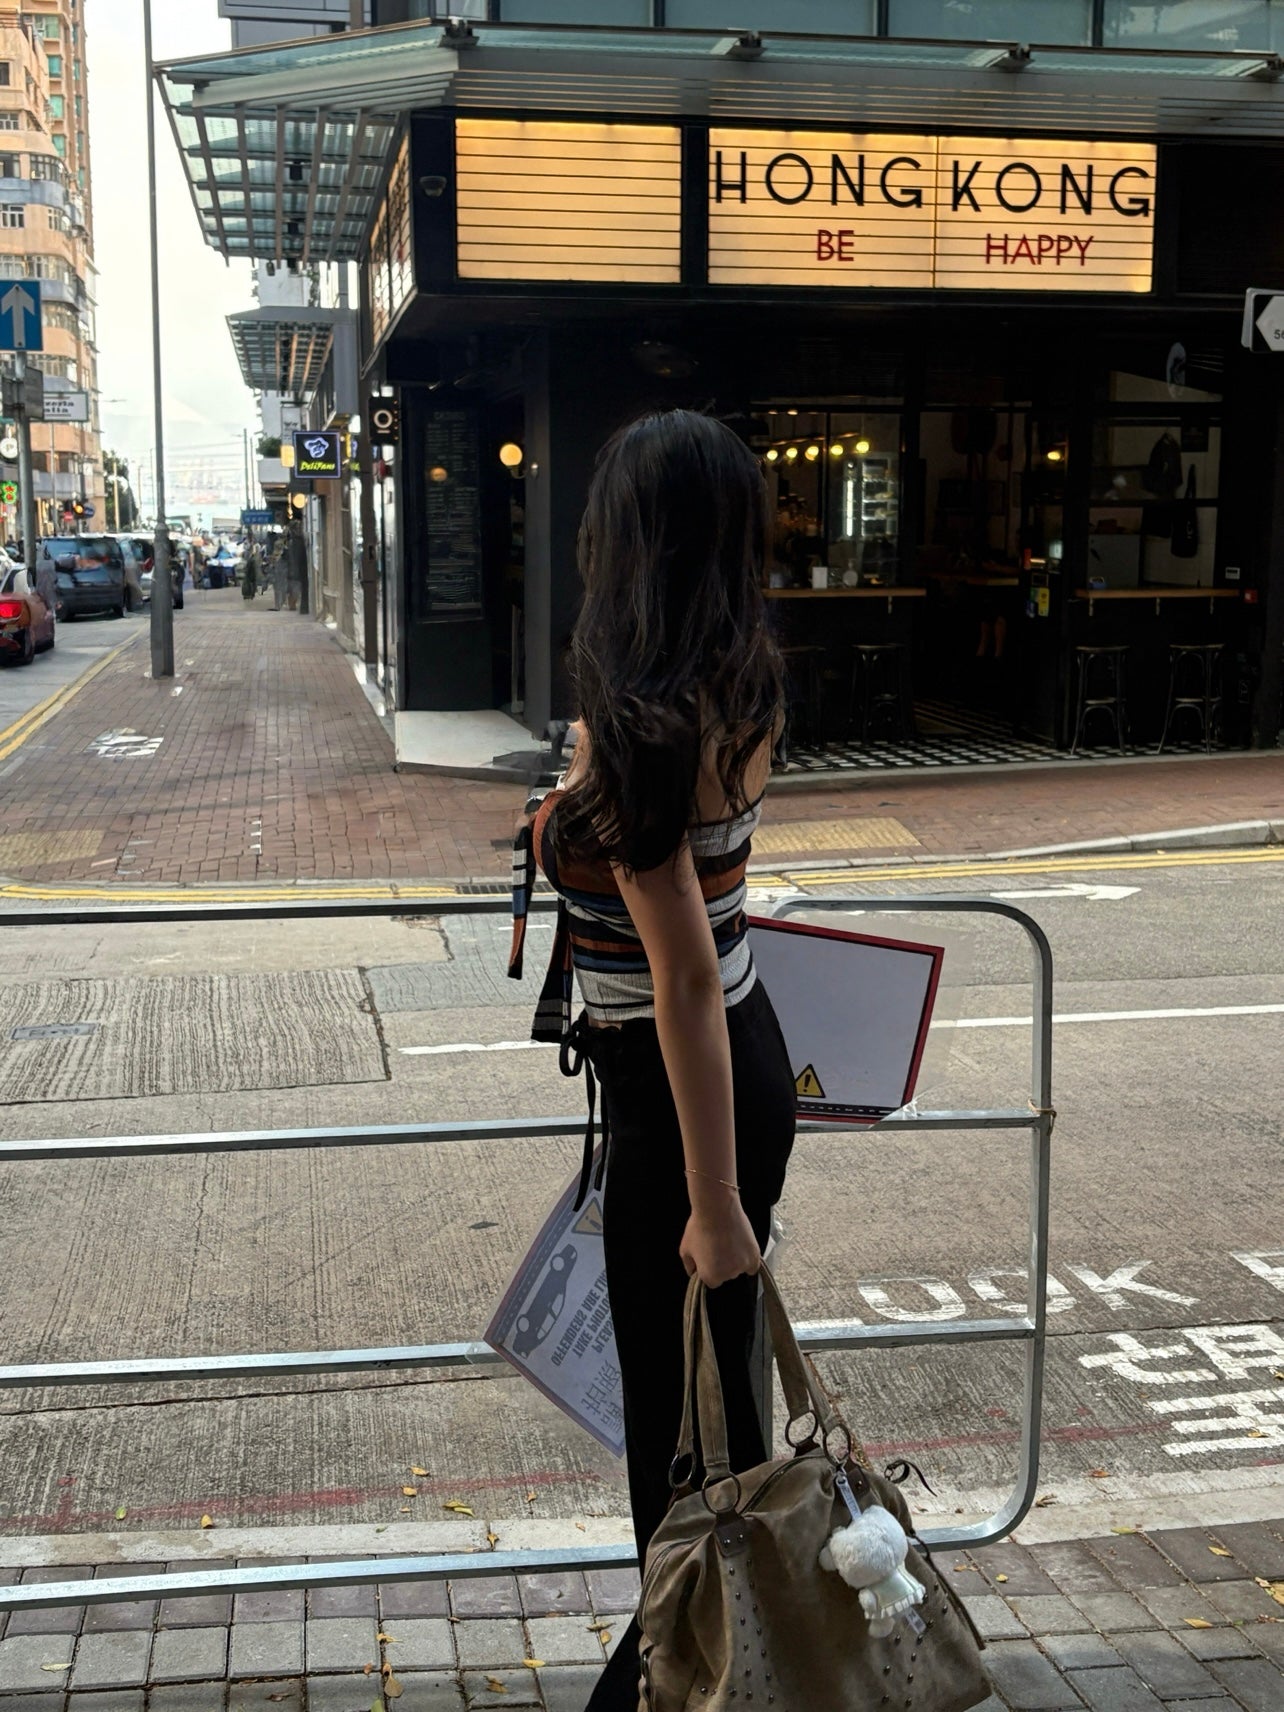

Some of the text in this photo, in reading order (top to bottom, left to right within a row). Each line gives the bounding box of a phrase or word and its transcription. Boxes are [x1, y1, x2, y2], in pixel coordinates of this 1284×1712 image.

[715, 150, 1150, 218] HONG KONG
[816, 229, 1094, 266] BE HAPPY
[790, 1257, 1200, 1326] OOK
